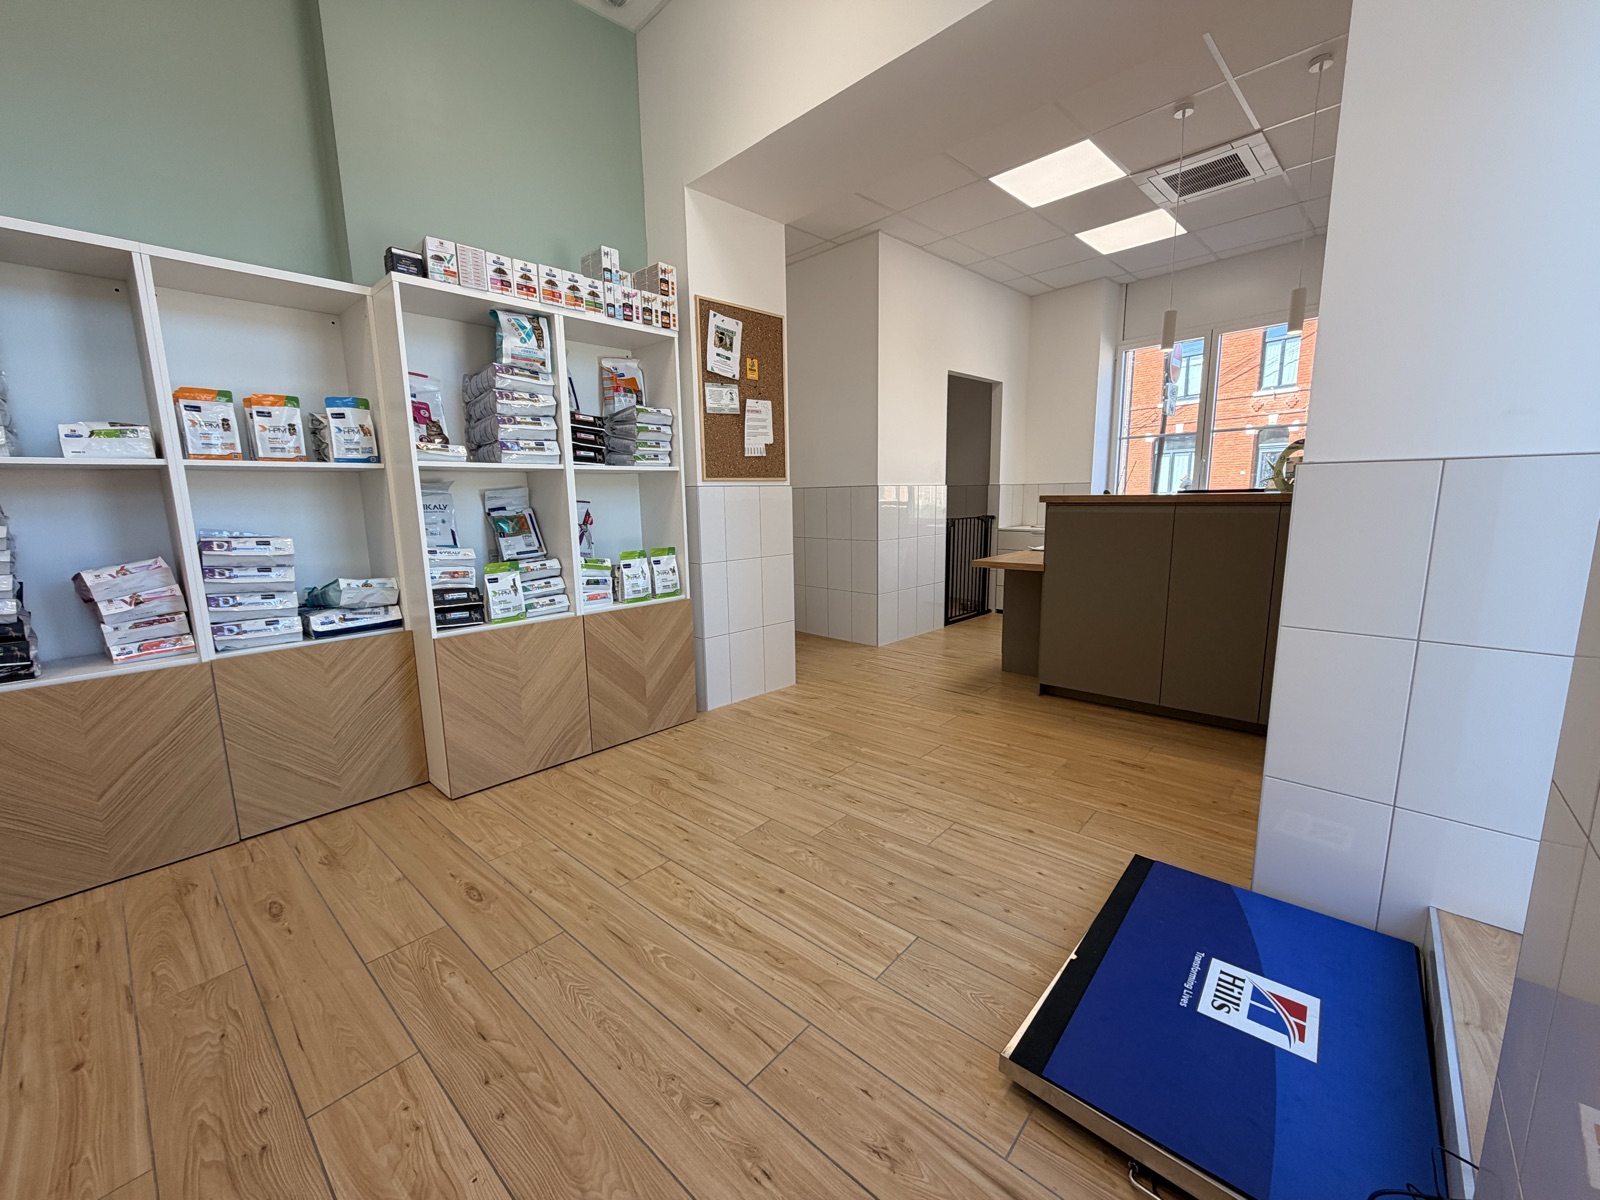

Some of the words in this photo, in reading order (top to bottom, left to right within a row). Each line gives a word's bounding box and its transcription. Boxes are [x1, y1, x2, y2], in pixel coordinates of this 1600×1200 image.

[1183, 951, 1206, 990] Transforming
[1179, 988, 1194, 1008] Lives
[1210, 969, 1246, 1015] Hill's
